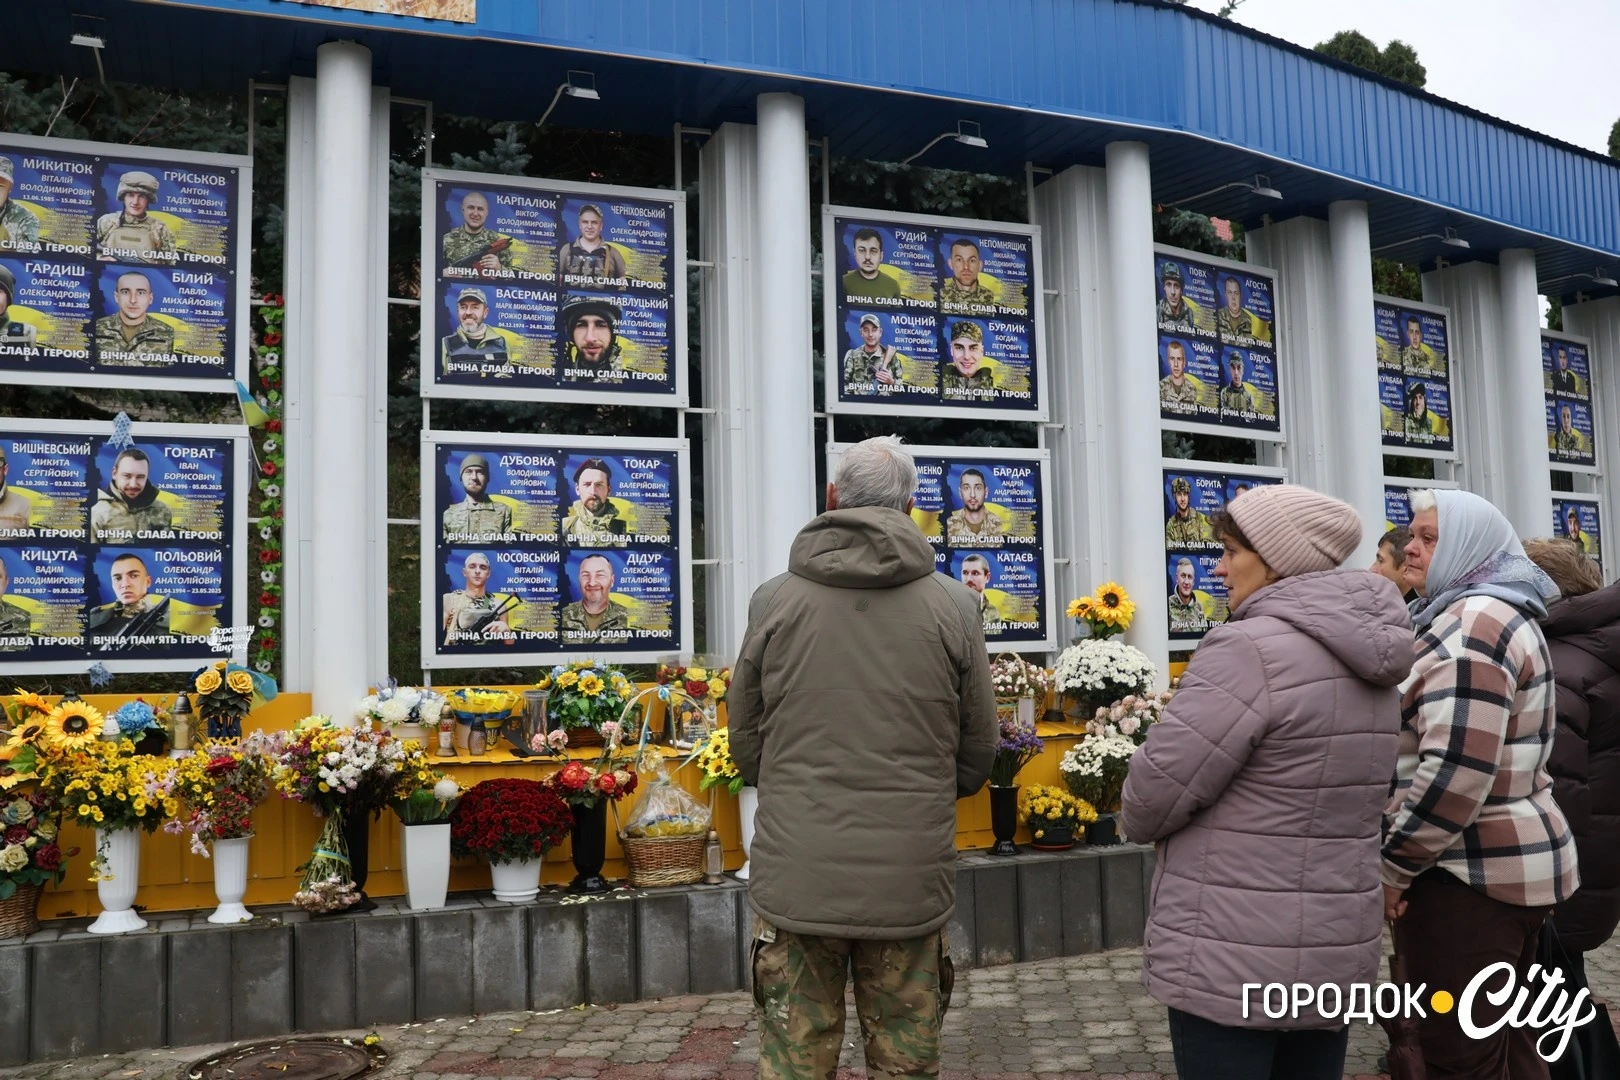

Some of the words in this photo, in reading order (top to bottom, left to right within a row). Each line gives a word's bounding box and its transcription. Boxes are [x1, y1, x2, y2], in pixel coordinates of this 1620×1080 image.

[23, 158, 93, 174] МИКИТЮК
[42, 175, 73, 183] ВІТАЛІЙ
[164, 171, 226, 186] ГРИСЬКОВ
[20, 184, 95, 196] ВОЛОДИМИРОВИЧ
[181, 187, 209, 195] АНТОН
[167, 196, 223, 207] ТАДЕУШОВИЧ
[497, 195, 556, 209] КАРПАЛЮК
[611, 205, 665, 219] ЧЕРНІХОВСЬКИЙ
[497, 218, 557, 229] ВОЛОДИМИРОВИЧ
[611, 228, 667, 238] ОЛЕКСАНДРОВИЧ
[896, 231, 927, 242] РУДИЙ
[1, 240, 41, 250] СЛАВА
[46, 243, 91, 254] ГЕРОЮ!
[980, 239, 1026, 252] НЕПОМНЯЩИХ
[103, 248, 138, 257] ВІЧНА
[142, 250, 180, 261] СЛАВА
[184, 254, 226, 264] ГЕРОЮ!
[893, 252, 929, 260] СЕРГІЙОВИЧ
[26, 263, 85, 277] ГАРДИШ
[448, 267, 478, 275] ВІЧНА
[482, 269, 515, 278] СЛАВА
[519, 272, 555, 281] ГЕРОЮ!
[1189, 267, 1206, 278] ПОВХ
[31, 278, 80, 288] ОЛЕКСАНДР
[172, 272, 213, 285] БІЛИЙ
[565, 275, 594, 284] ВІЧНА
[597, 278, 628, 286] СЛАВА
[632, 280, 666, 289] ГЕРОЮ!
[1246, 280, 1267, 291] АГОСТА
[20, 288, 90, 299] ОЛЕКСАНДРОВИЧ
[496, 289, 556, 301] ВАСЕРМАН
[162, 297, 222, 307] МИХАЙЛОВИЧ
[610, 297, 668, 310] ПАВЛУЦЬКИЙ
[847, 295, 873, 303] ВІЧНА
[876, 297, 904, 306] СЛАВА
[906, 299, 937, 308] ГЕРОЮ!
[513, 304, 558, 312] МИКОЛАЙОВИЧ
[971, 304, 996, 312] СЛАВА
[999, 306, 1027, 315] ГЕРОЮ!
[612, 320, 666, 328] АНАТОЛІЙОВИЧ
[891, 316, 936, 326] МОЦНИЙ
[989, 322, 1025, 333] БУРЛИК
[1159, 323, 1175, 331] ВІЧНА
[1177, 326, 1195, 334] СЛАВА
[1197, 329, 1216, 338] ГЕРОЮ!
[0, 346, 40, 356] СЛАВА
[44, 348, 89, 358] ГЕРОЮ!
[1192, 343, 1214, 353] ЧАЙКА
[100, 352, 136, 360] ВІЧНА
[140, 353, 178, 362] СЛАВА
[182, 356, 224, 364] ГЕРОЮ!
[1250, 353, 1270, 363] БУДУСЬ
[448, 363, 478, 372] ВІЧНА
[482, 364, 515, 374] СЛАВА
[519, 367, 555, 375] ГЕРОЮ!
[565, 369, 594, 377] ВІЧНА
[597, 370, 630, 379] СЛАВА
[632, 372, 667, 381] ГЕРОЮ!
[13, 443, 91, 455] ВИШНЕВСЬКИЙ
[165, 448, 215, 458] ГОРВАТ
[500, 456, 555, 467] ДУБОВКА
[623, 459, 660, 468] ТОКАР
[24, 468, 79, 477] СЕРГІЙОВИЧ
[994, 468, 1031, 478] БАРДАР
[1196, 479, 1222, 489] БОРИТА
[40, 529, 85, 537] ГЕРОЮ!
[137, 530, 175, 539] СЛАВА
[484, 533, 517, 541] СЛАВА
[22, 550, 78, 563] КИЦУТА
[155, 550, 222, 562] ПОЛЬОВИЙ
[497, 551, 560, 562] КОСОВСЬКИЙ
[627, 554, 661, 565] ДІДУР
[998, 553, 1033, 562] КАТАЄВ
[36, 566, 64, 574] ВАДИМ
[515, 566, 544, 574] ВІТАЛІЙ
[14, 577, 85, 585] ВОЛОДИМИРОВИЧ
[155, 576, 222, 584] АНАТОЛІЙОВИЧ
[484, 632, 518, 640] СЛАВА
[568, 630, 598, 639] ВІЧНА
[38, 637, 84, 645] ГЕРОЮ!
[94, 636, 127, 645] ВІЧНА
